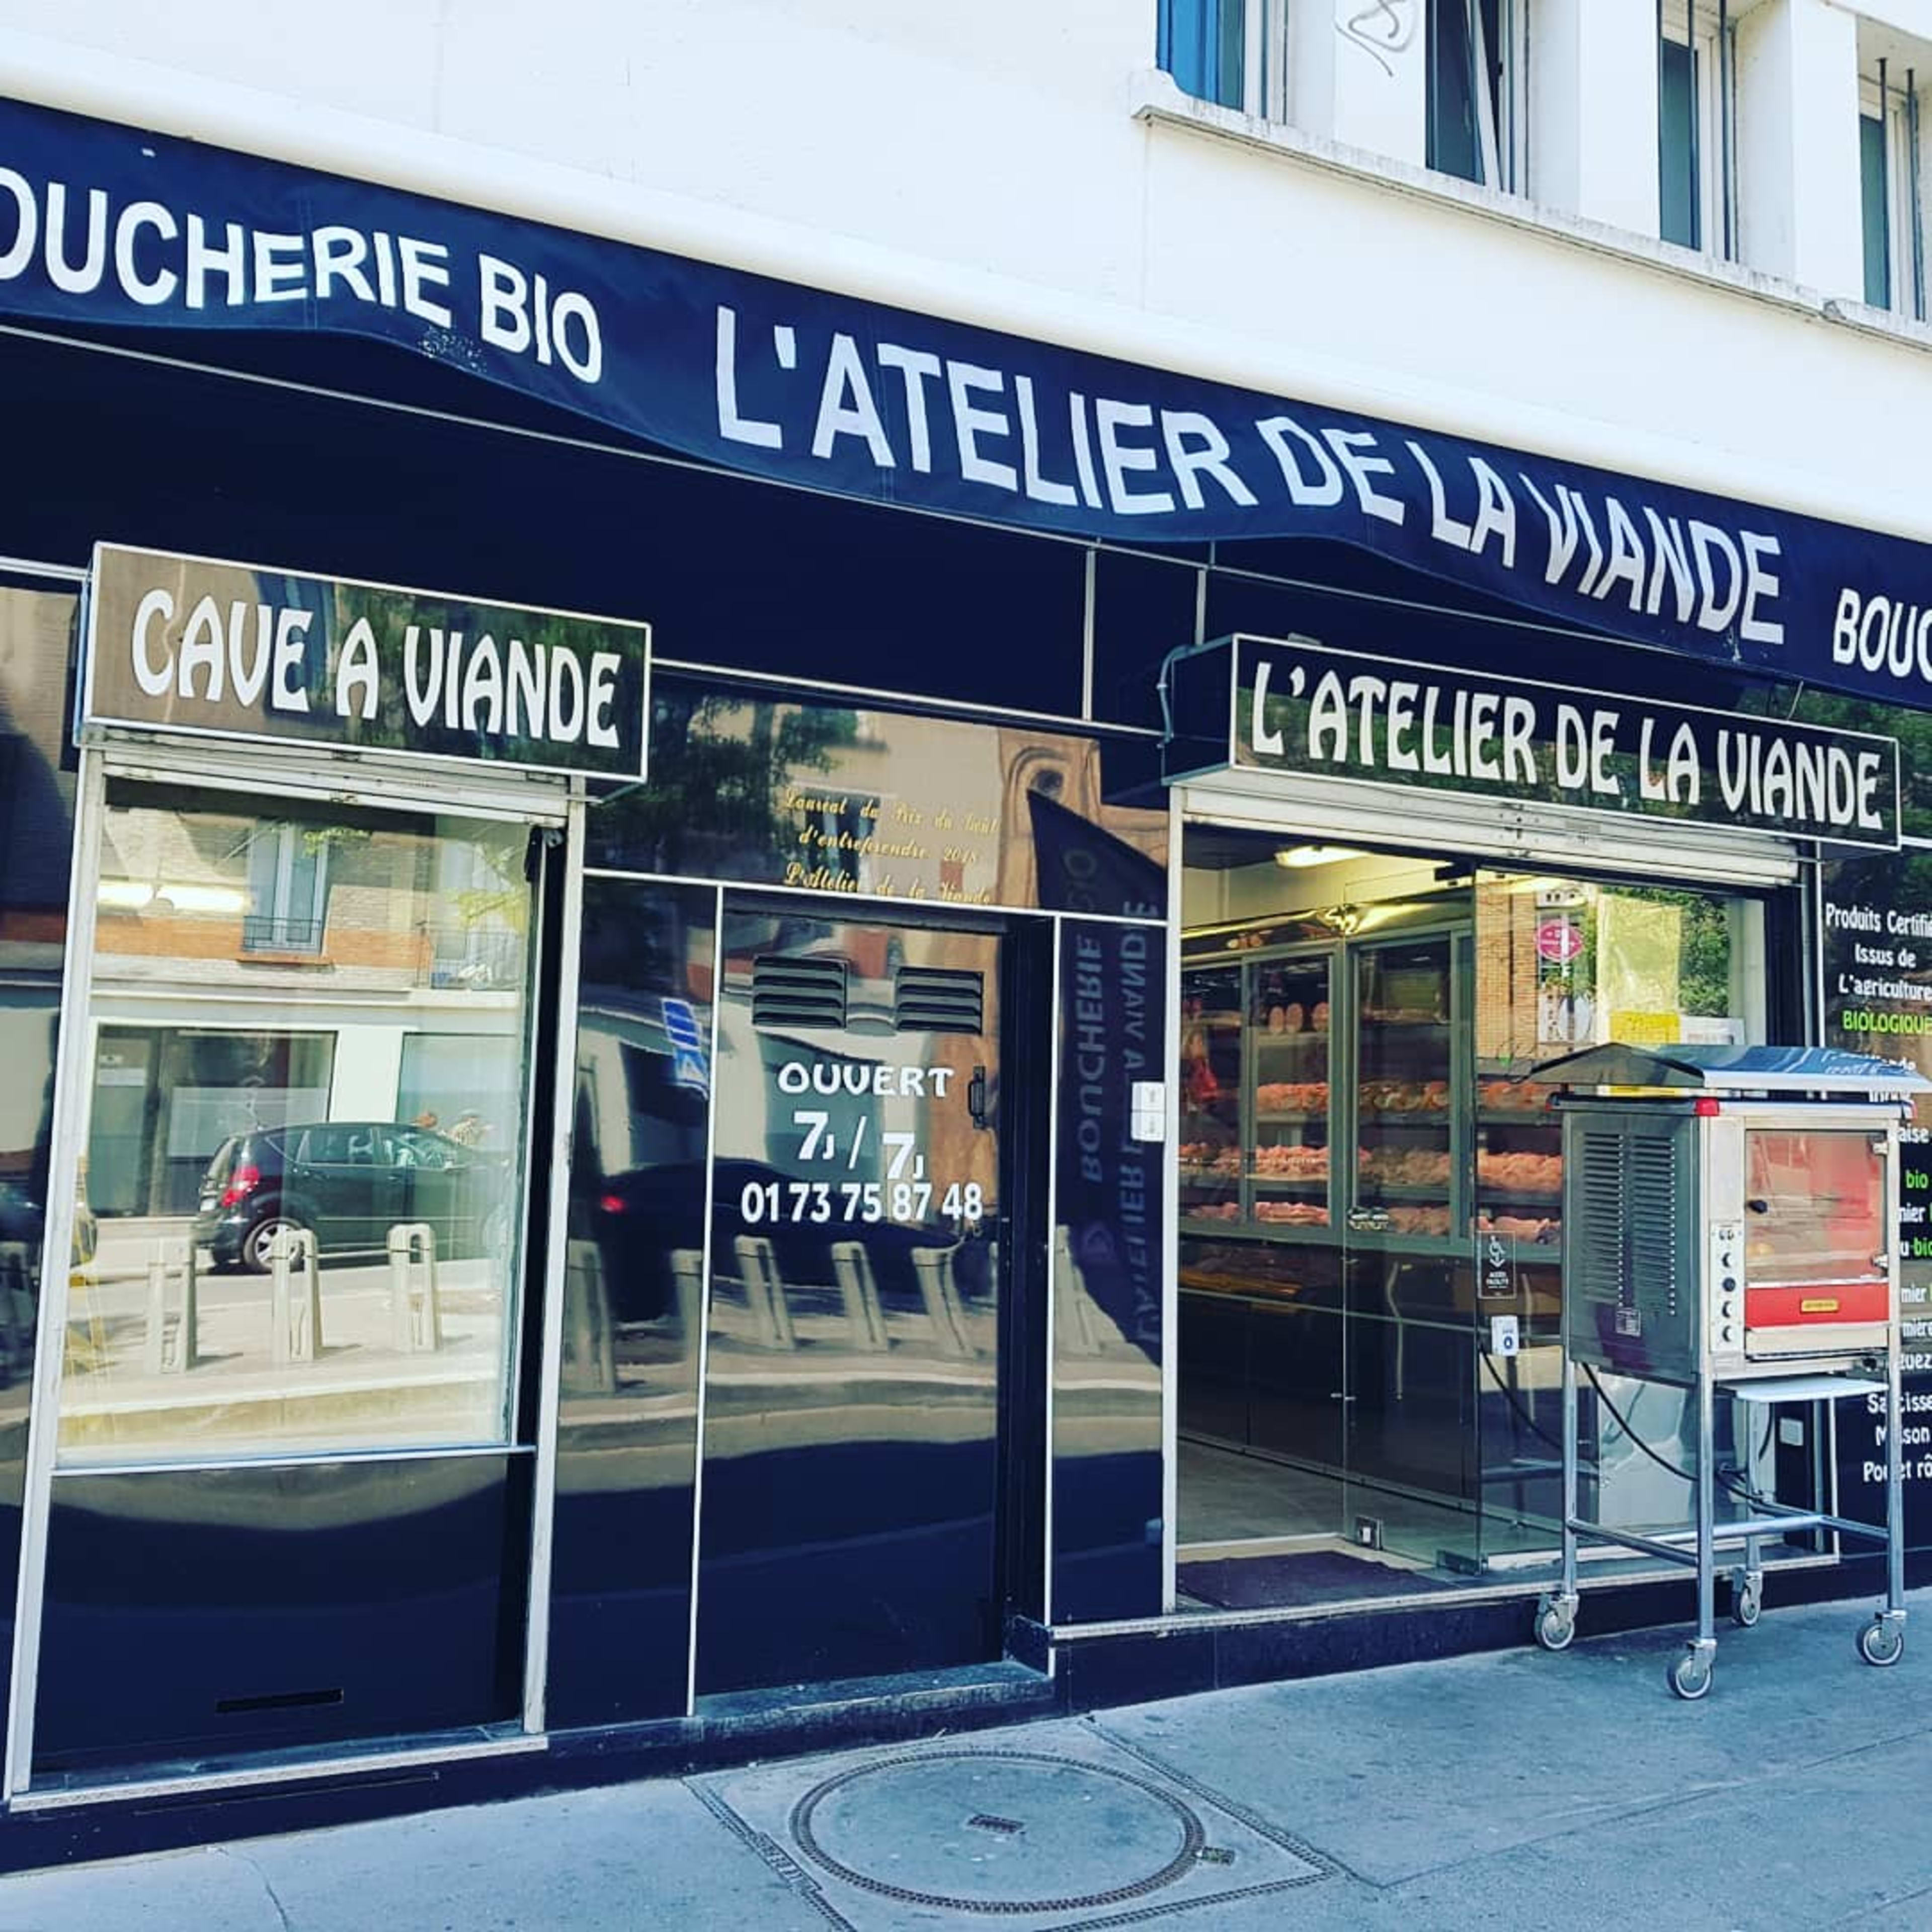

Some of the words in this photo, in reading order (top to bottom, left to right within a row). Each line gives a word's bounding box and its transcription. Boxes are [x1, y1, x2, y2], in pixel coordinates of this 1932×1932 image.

[479, 253, 602, 383] BIO
[716, 305, 1258, 515] L'ATELIER
[1255, 417, 1405, 526] DE
[1405, 441, 1516, 568] LA
[1518, 472, 1784, 645] VIANDE
[132, 589, 313, 713] CAVE
[336, 616, 380, 720] A
[404, 625, 621, 748] VIANDE
[1252, 661, 1537, 784] L'ATELIER
[1557, 704, 1620, 795] DE
[1640, 717, 1700, 805] LA
[1717, 729, 1883, 829] VIANDE
[1826, 903, 1882, 933] Produits
[1855, 943, 1894, 967] Issus
[1897, 948, 1916, 969] de
[1839, 973, 1932, 1002] L'agriculture
[1842, 1010, 1932, 1035] BIOLOGIQUE
[778, 1062, 954, 1097] OUVERT
[1897, 1123, 1929, 1143] aise
[1905, 1168, 1928, 1189] bio
[742, 1182, 779, 1223] 01
[789, 1182, 831, 1223] 73
[841, 1182, 882, 1223] 75
[892, 1182, 932, 1222] 87
[942, 1182, 983, 1221] 48
